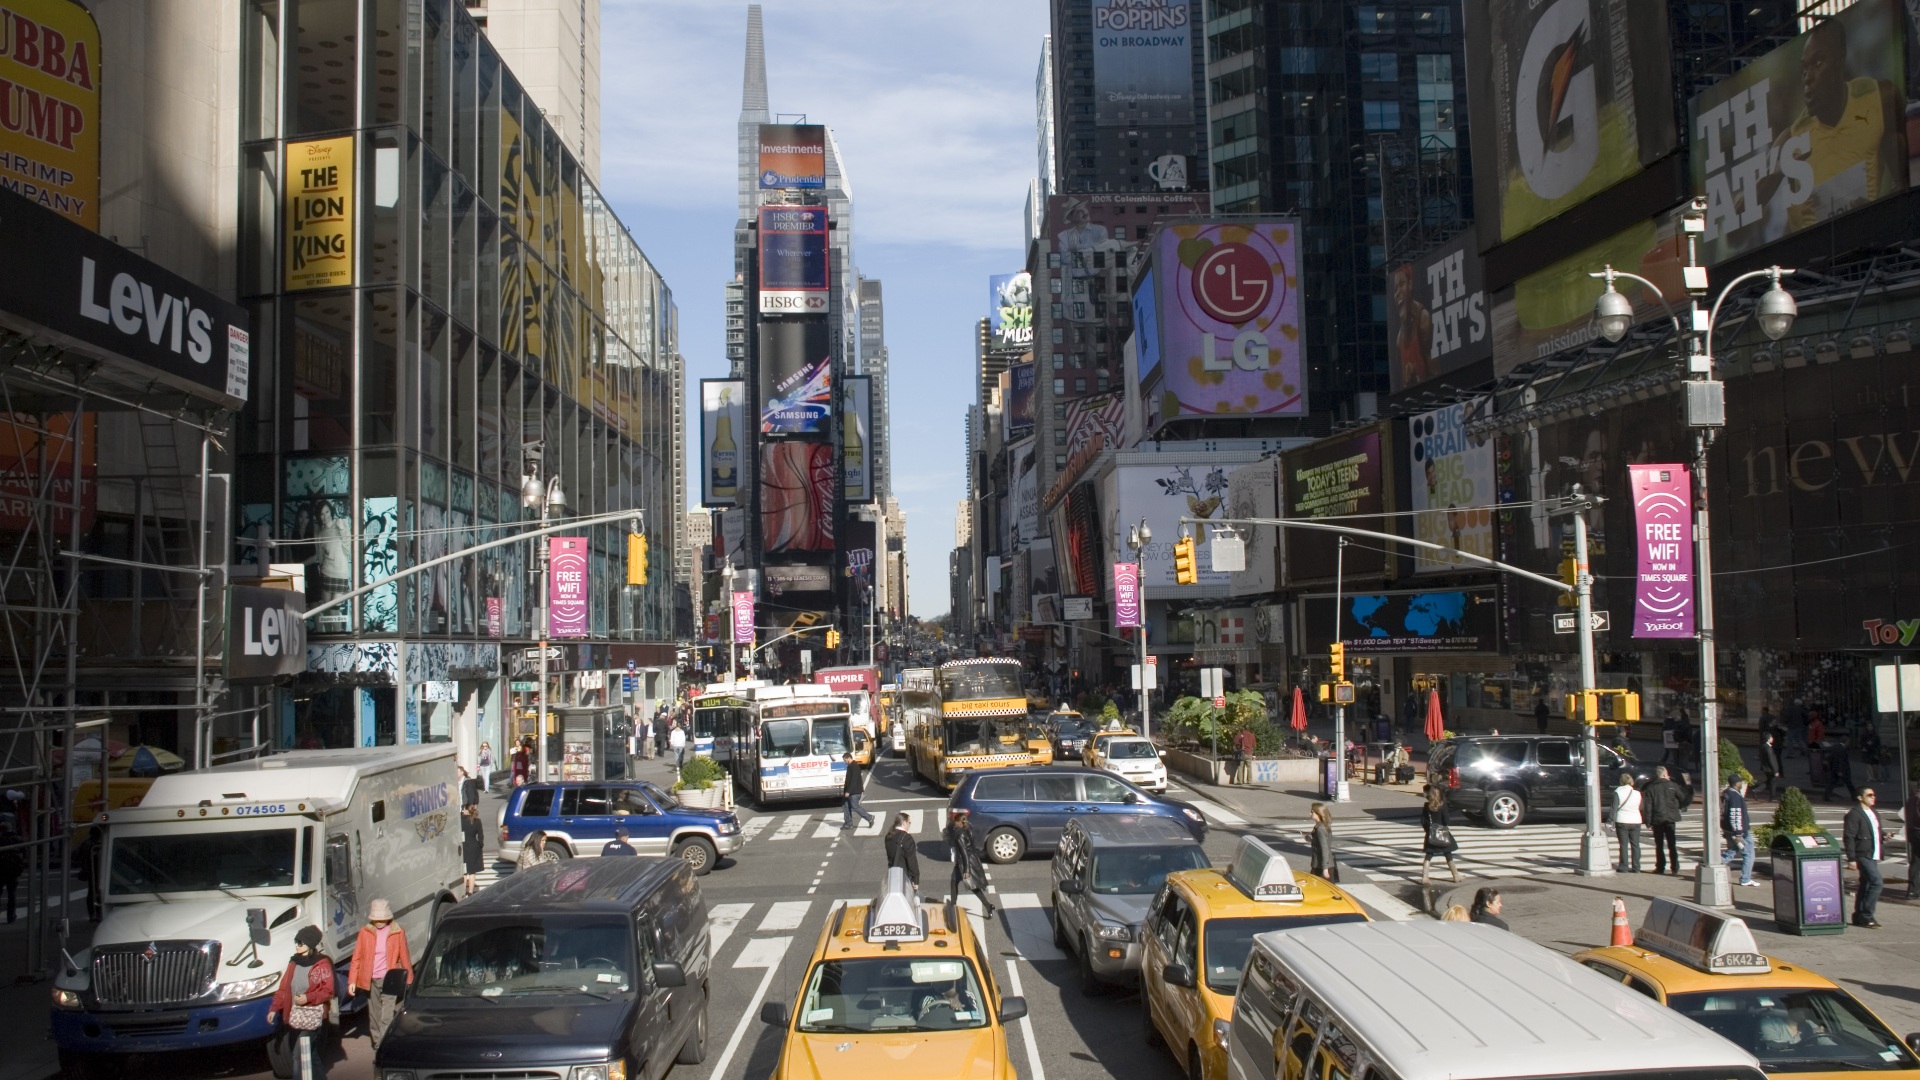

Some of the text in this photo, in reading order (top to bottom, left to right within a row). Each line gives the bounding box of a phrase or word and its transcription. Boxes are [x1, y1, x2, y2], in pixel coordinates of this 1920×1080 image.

[1096, 5, 1187, 30] POPPINS
[1100, 36, 1184, 47] ON BROADWAY
[1696, 77, 1773, 174] TH
[305, 145, 333, 156] Disney
[760, 143, 823, 154] Investments
[301, 165, 338, 188] THE
[779, 174, 824, 184] Prudential
[1702, 129, 1815, 244] AT'S
[1091, 194, 1193, 203] 100% Colombian Coffee
[294, 196, 344, 231] LION
[773, 212, 799, 221] HSBC
[774, 222, 815, 230] PREMIER
[292, 233, 346, 271] KING
[777, 249, 812, 257] Wherever
[1427, 249, 1466, 310] TH
[763, 296, 804, 309] HSBC
[80, 256, 212, 364] Levi's
[1430, 290, 1487, 360] AT'S
[1202, 330, 1270, 372] LG
[776, 362, 814, 392] SAMSUNG
[774, 410, 819, 420] SAMSUNG
[1437, 404, 1464, 433] BIG
[713, 450, 736, 458] Corona
[1434, 455, 1465, 482] BIG
[1307, 470, 1336, 492] TODAY'S
[1337, 463, 1360, 484] TEENS
[1428, 478, 1475, 509] HEAD
[1324, 499, 1358, 516] POSITIVITY
[1645, 524, 1682, 541] FREE
[1648, 543, 1679, 560] WIFI
[1652, 563, 1676, 571] NOW IN
[556, 571, 582, 582] FREE
[1641, 573, 1688, 583] TIMES SQUARE
[557, 583, 580, 593] WIFI
[1120, 591, 1134, 600] WIFI
[1643, 622, 1684, 632] YAHOO!
[1353, 638, 1376, 646] $1,000
[1393, 637, 1407, 645] TEXT
[824, 673, 864, 684] EMPIRE
[961, 702, 973, 710] big
[236, 804, 287, 816] 074505
[1268, 885, 1287, 894] 3J31
[883, 925, 906, 935] 5P82
[1726, 954, 1753, 966] 6K42
